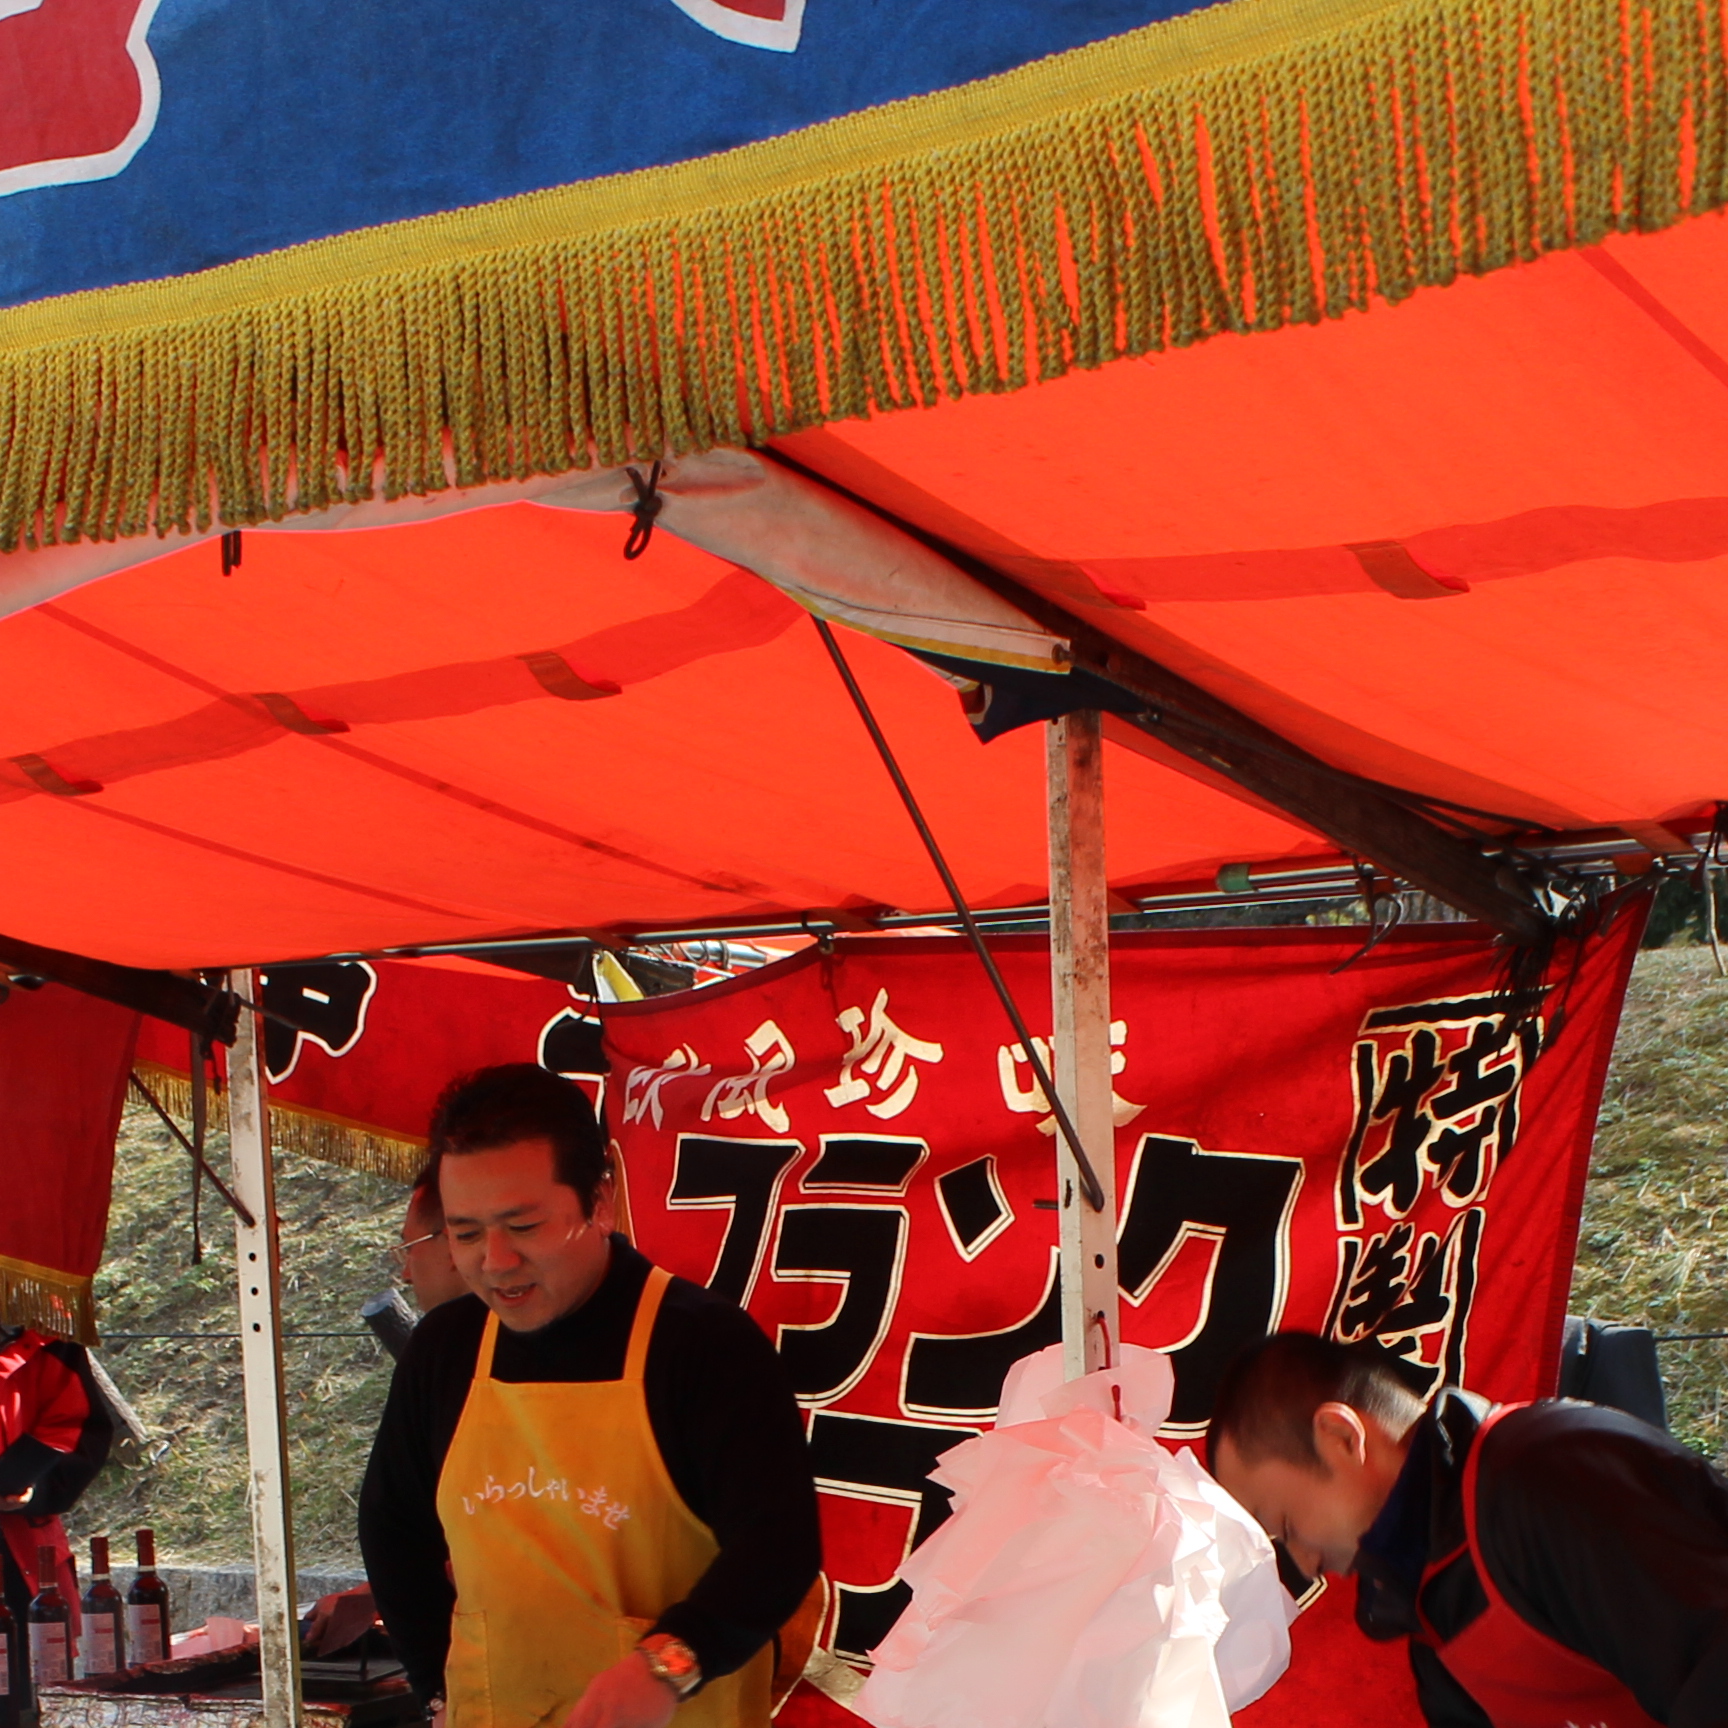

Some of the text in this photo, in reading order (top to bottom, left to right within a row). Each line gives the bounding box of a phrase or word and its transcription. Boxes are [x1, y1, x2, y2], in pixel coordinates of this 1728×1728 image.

[462, 1466, 631, 1531] いらっしゃいませ
